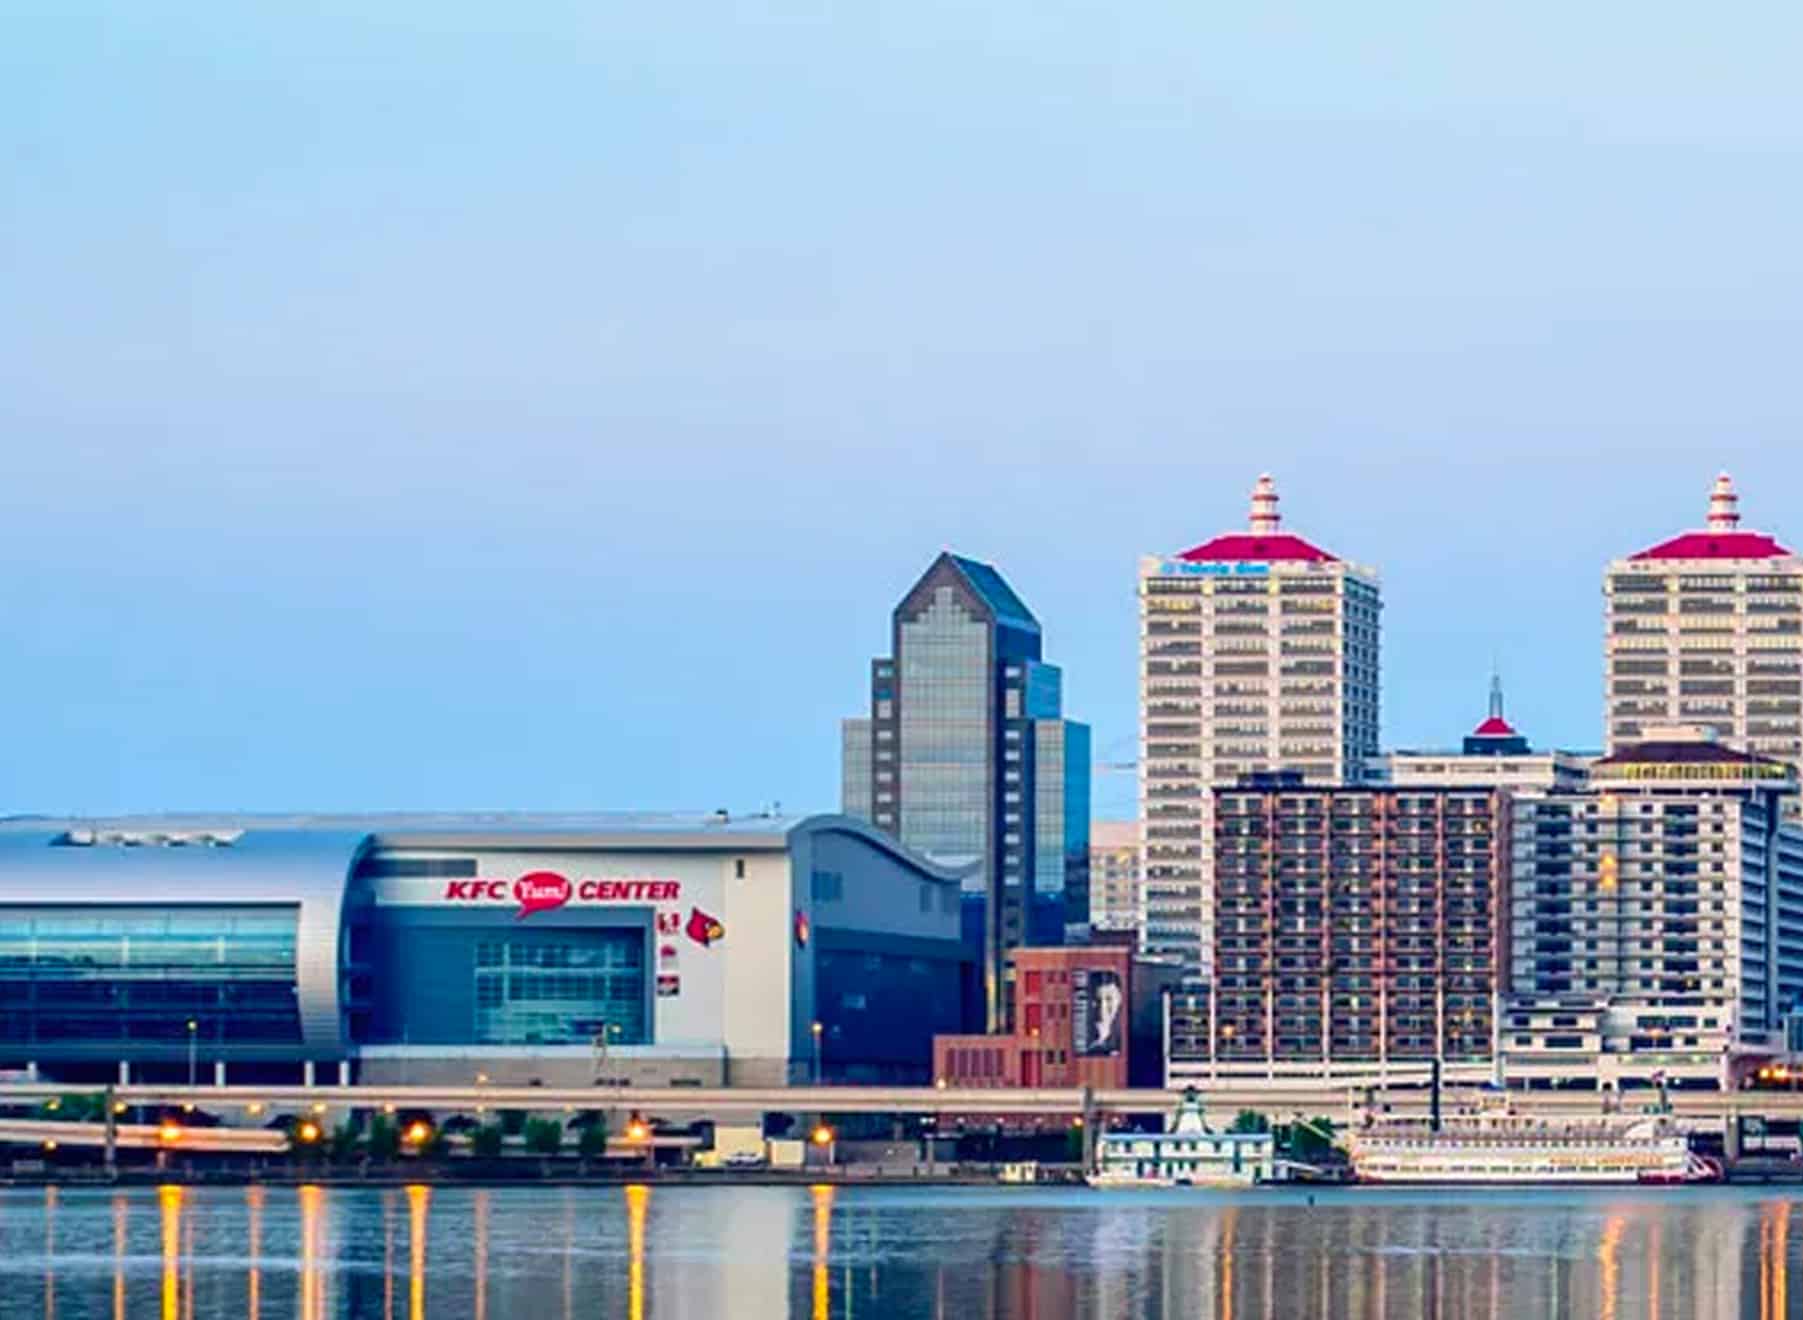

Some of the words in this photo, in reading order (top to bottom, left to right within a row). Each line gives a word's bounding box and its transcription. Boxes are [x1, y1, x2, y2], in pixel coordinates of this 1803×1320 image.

[446, 881, 507, 900] KFC
[518, 880, 568, 900] Yum!
[578, 881, 681, 900] CENTER
